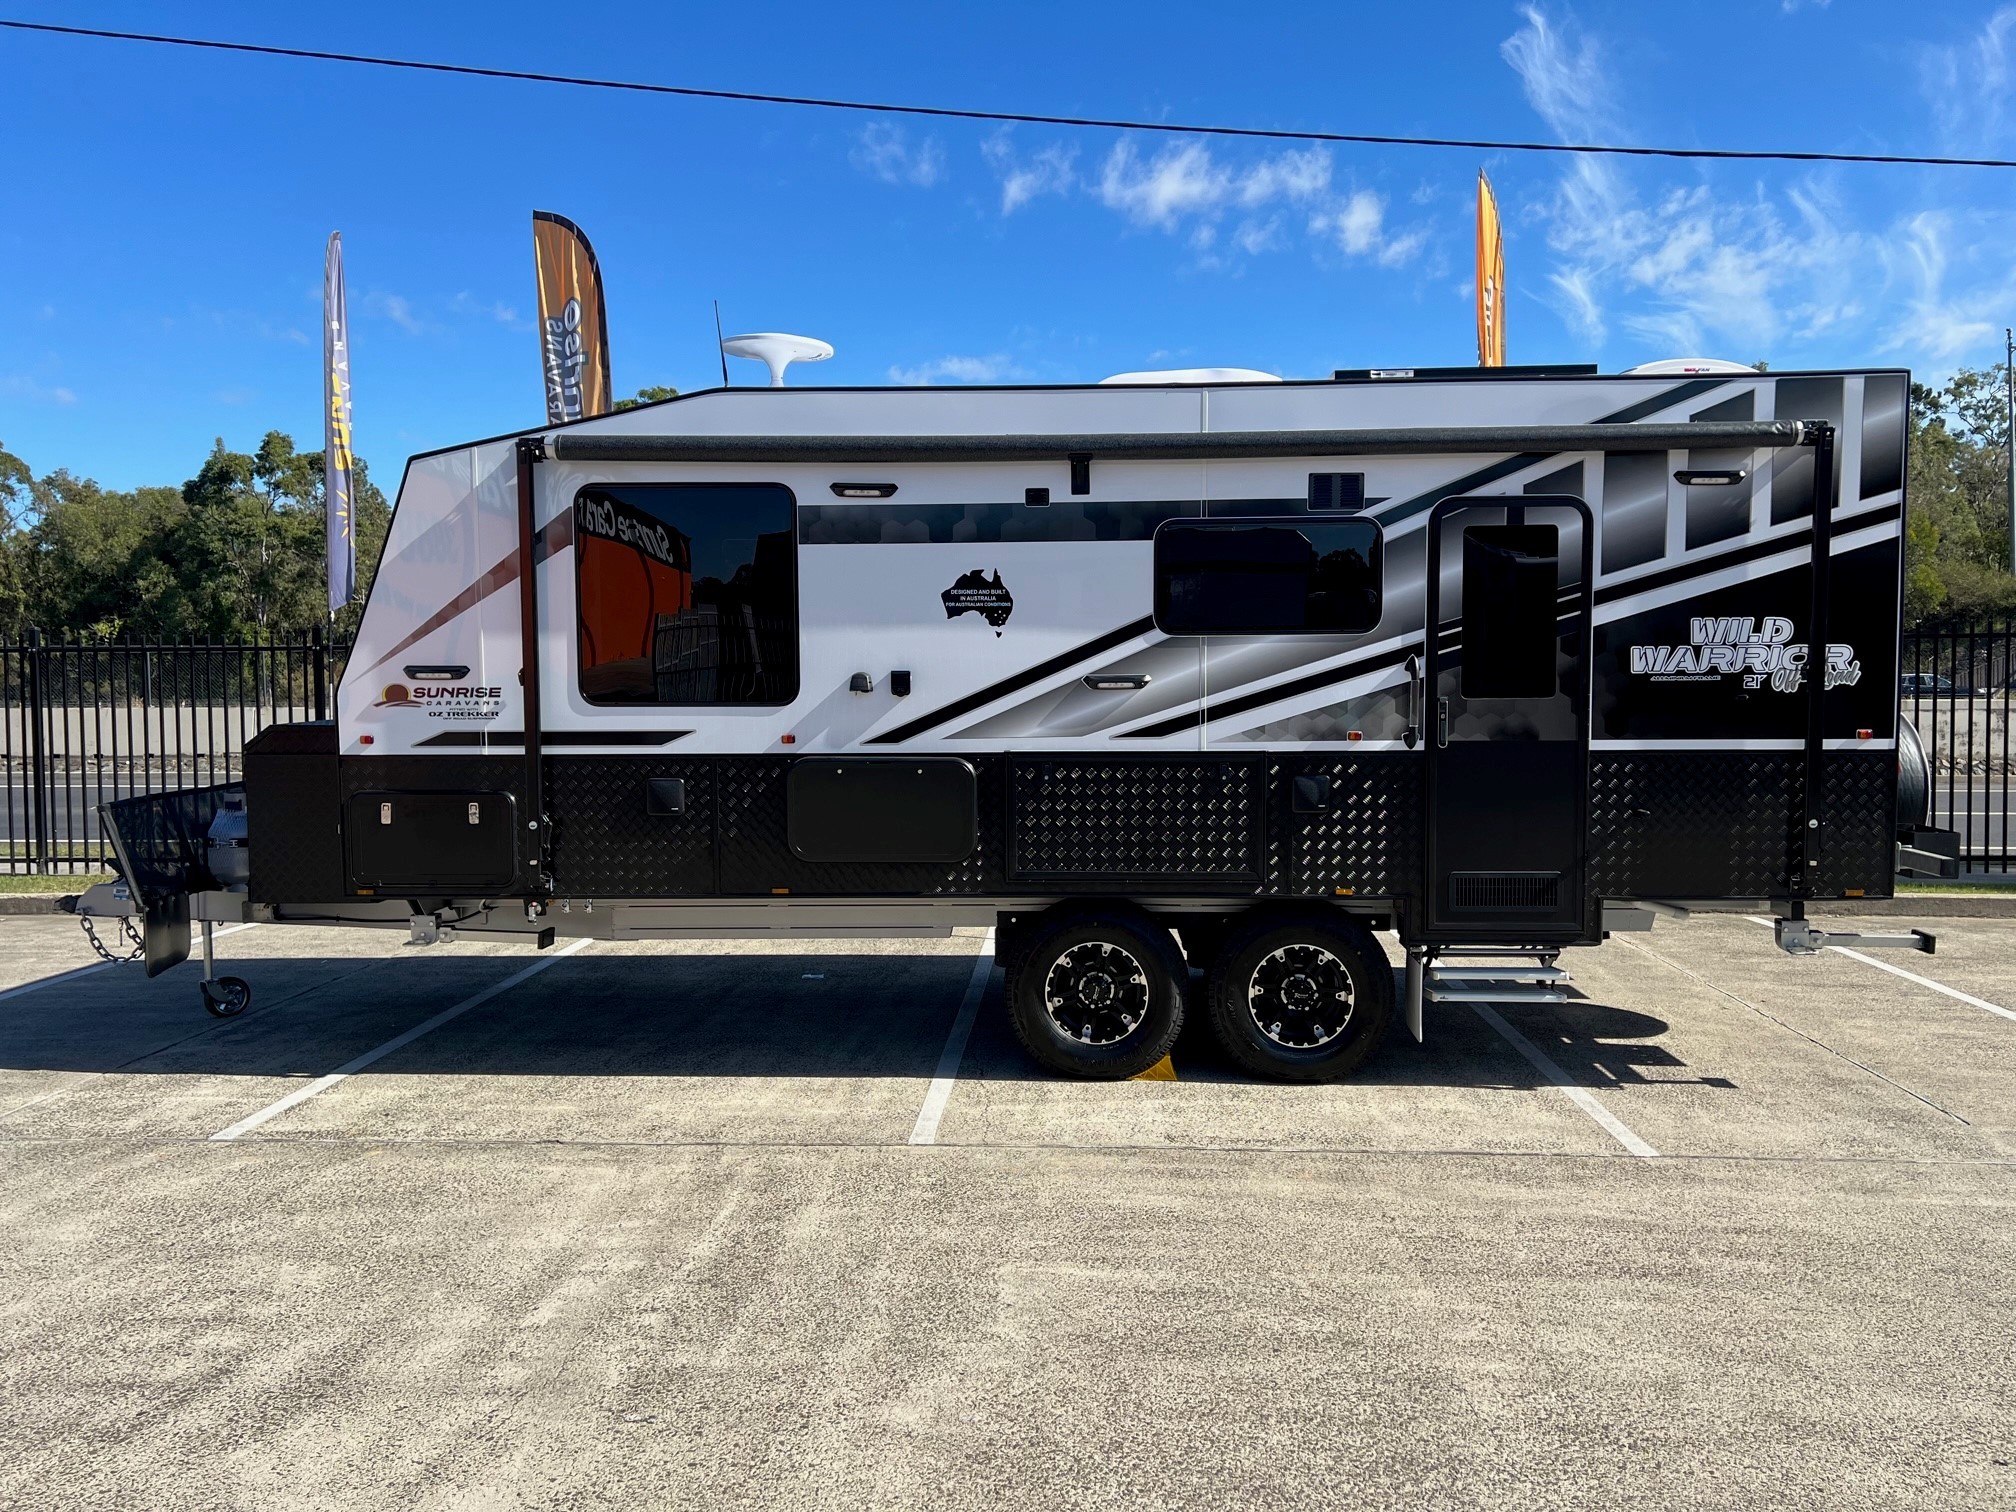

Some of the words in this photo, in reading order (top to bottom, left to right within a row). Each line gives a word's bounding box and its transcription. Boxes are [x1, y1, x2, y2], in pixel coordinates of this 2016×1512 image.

[1691, 616, 1794, 645] WILD
[1630, 644, 1854, 674] WARRIOR
[413, 687, 502, 699] SUNRISE
